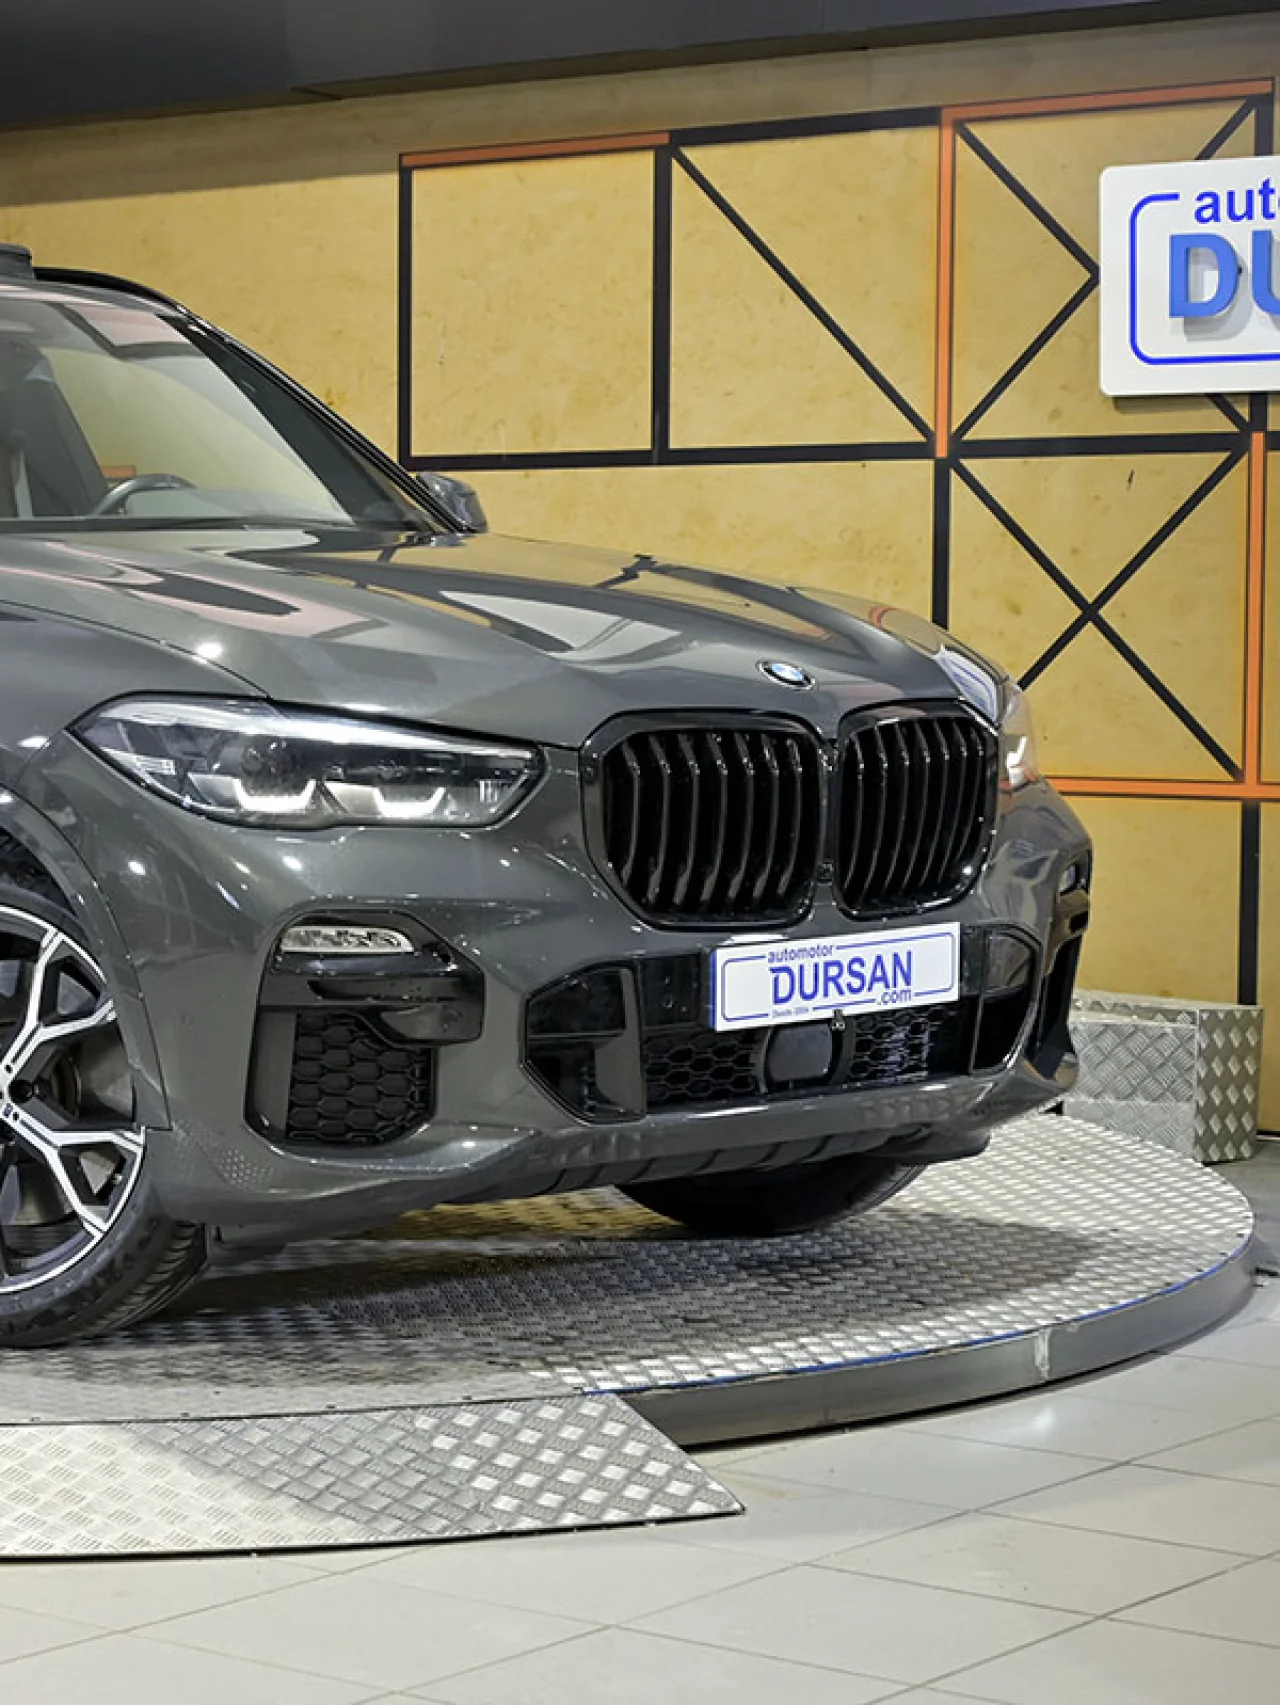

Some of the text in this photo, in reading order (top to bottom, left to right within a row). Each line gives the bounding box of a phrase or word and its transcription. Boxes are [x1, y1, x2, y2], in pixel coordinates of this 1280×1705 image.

[1194, 178, 1280, 224] aut
[767, 944, 834, 963] automotor
[769, 949, 912, 1005] DURSAN
[876, 988, 912, 1005] .com
